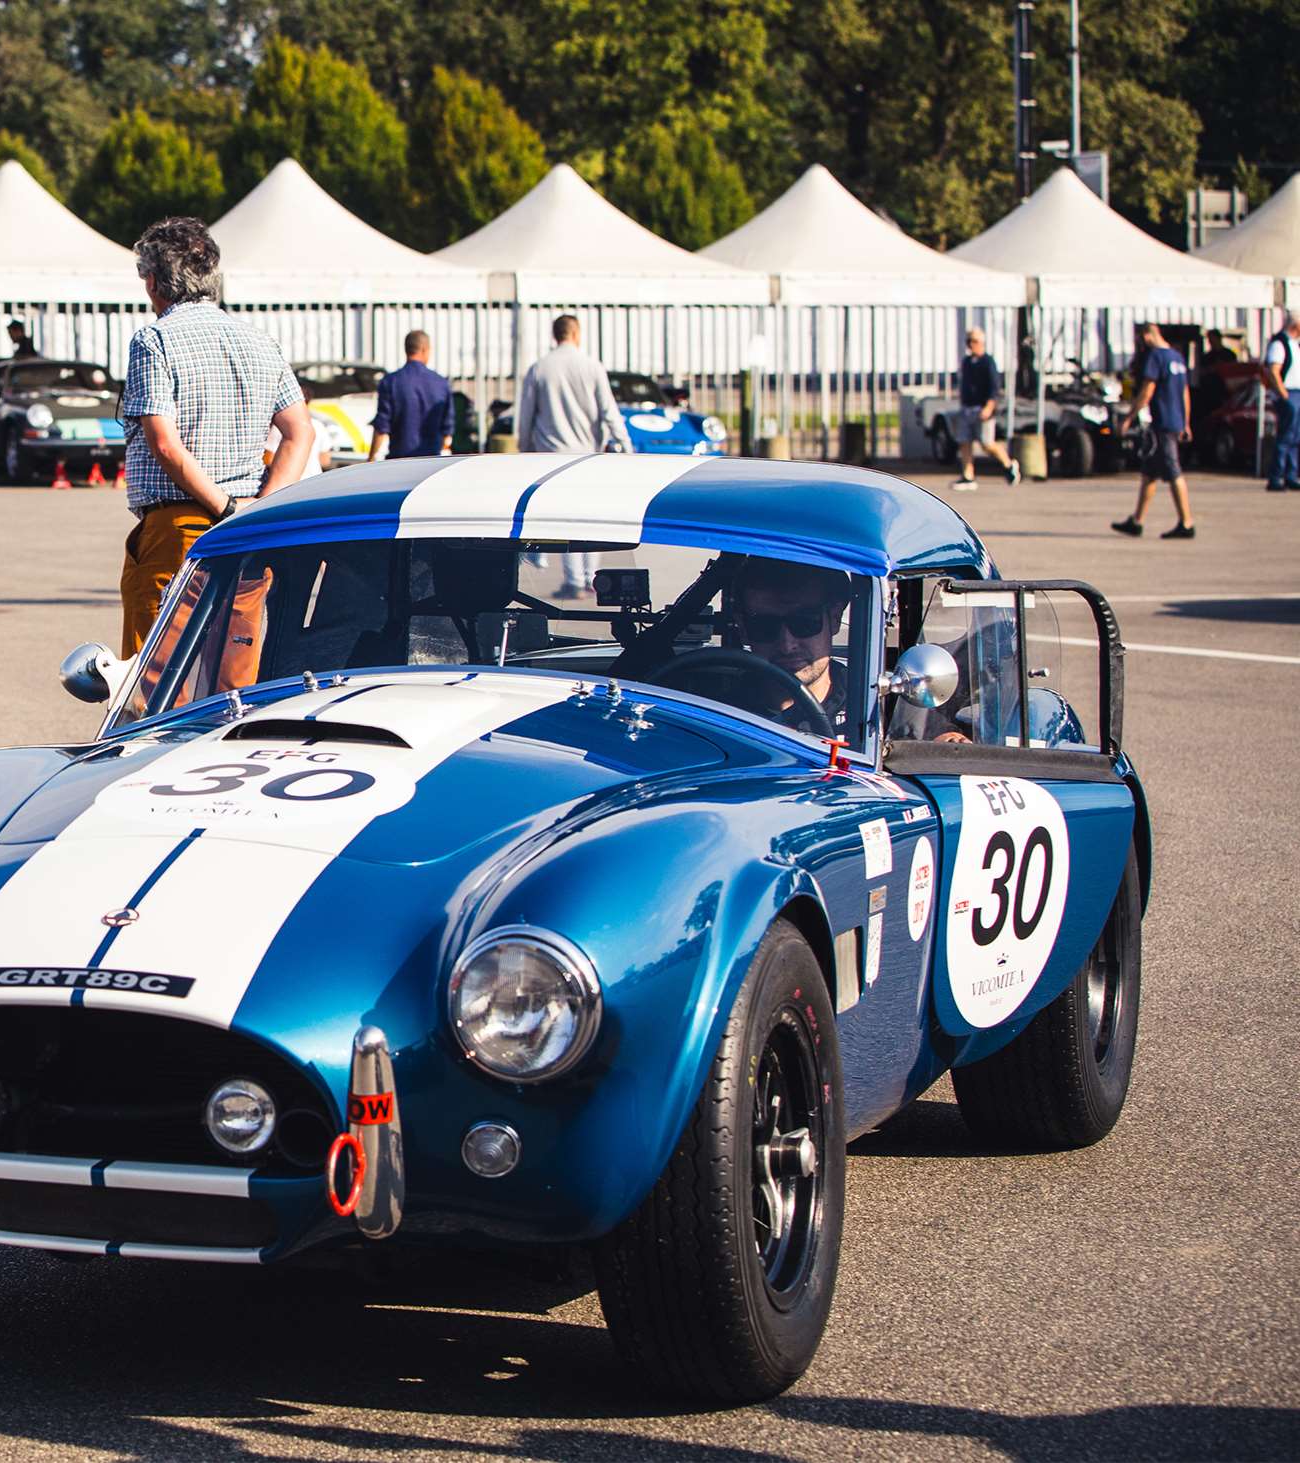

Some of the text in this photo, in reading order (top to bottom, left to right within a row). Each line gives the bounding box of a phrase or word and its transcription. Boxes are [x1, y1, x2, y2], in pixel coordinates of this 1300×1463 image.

[246, 750, 340, 763] EFG
[149, 763, 376, 801] 30
[971, 825, 1054, 946] 30
